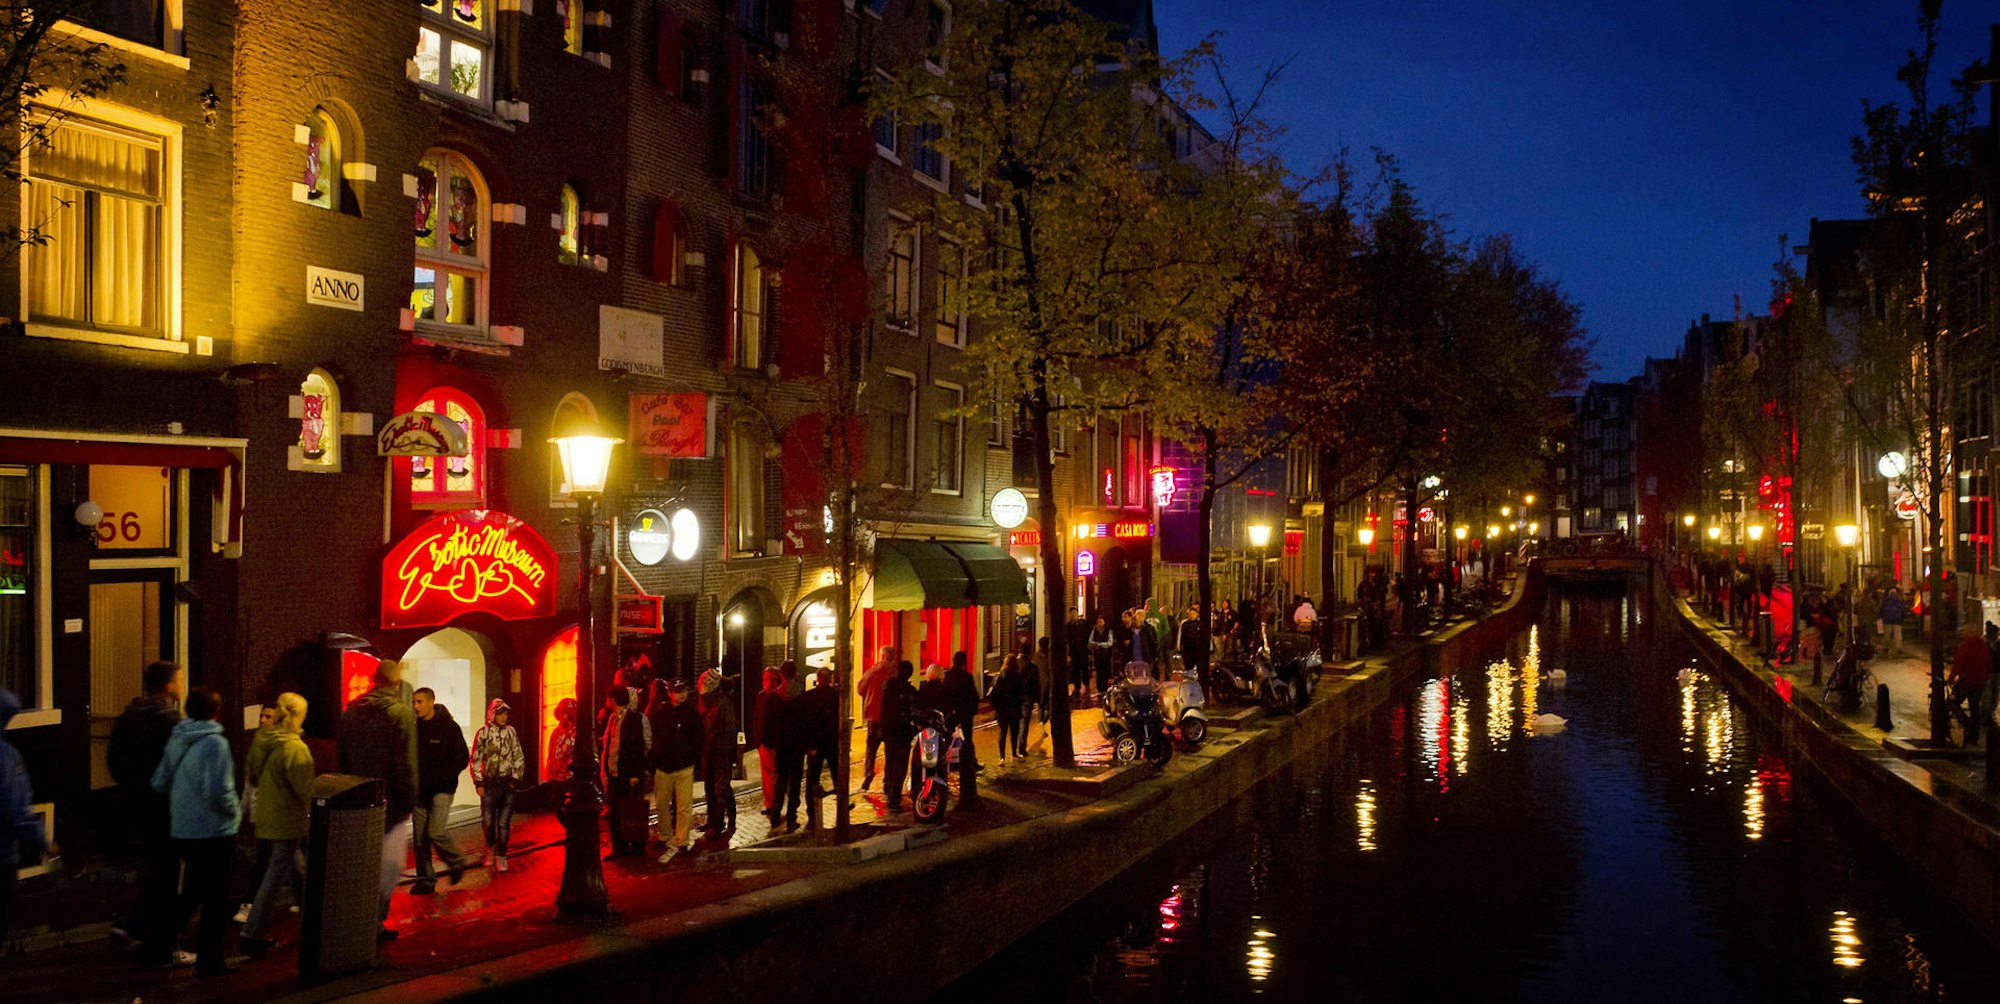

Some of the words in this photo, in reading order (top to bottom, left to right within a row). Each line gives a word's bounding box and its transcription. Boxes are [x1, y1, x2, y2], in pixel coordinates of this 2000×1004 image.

[312, 275, 360, 301] ANNO
[98, 511, 141, 542] 56
[1115, 523, 1132, 537] CASA
[398, 523, 481, 610] Erotic
[481, 524, 546, 588] Museum
